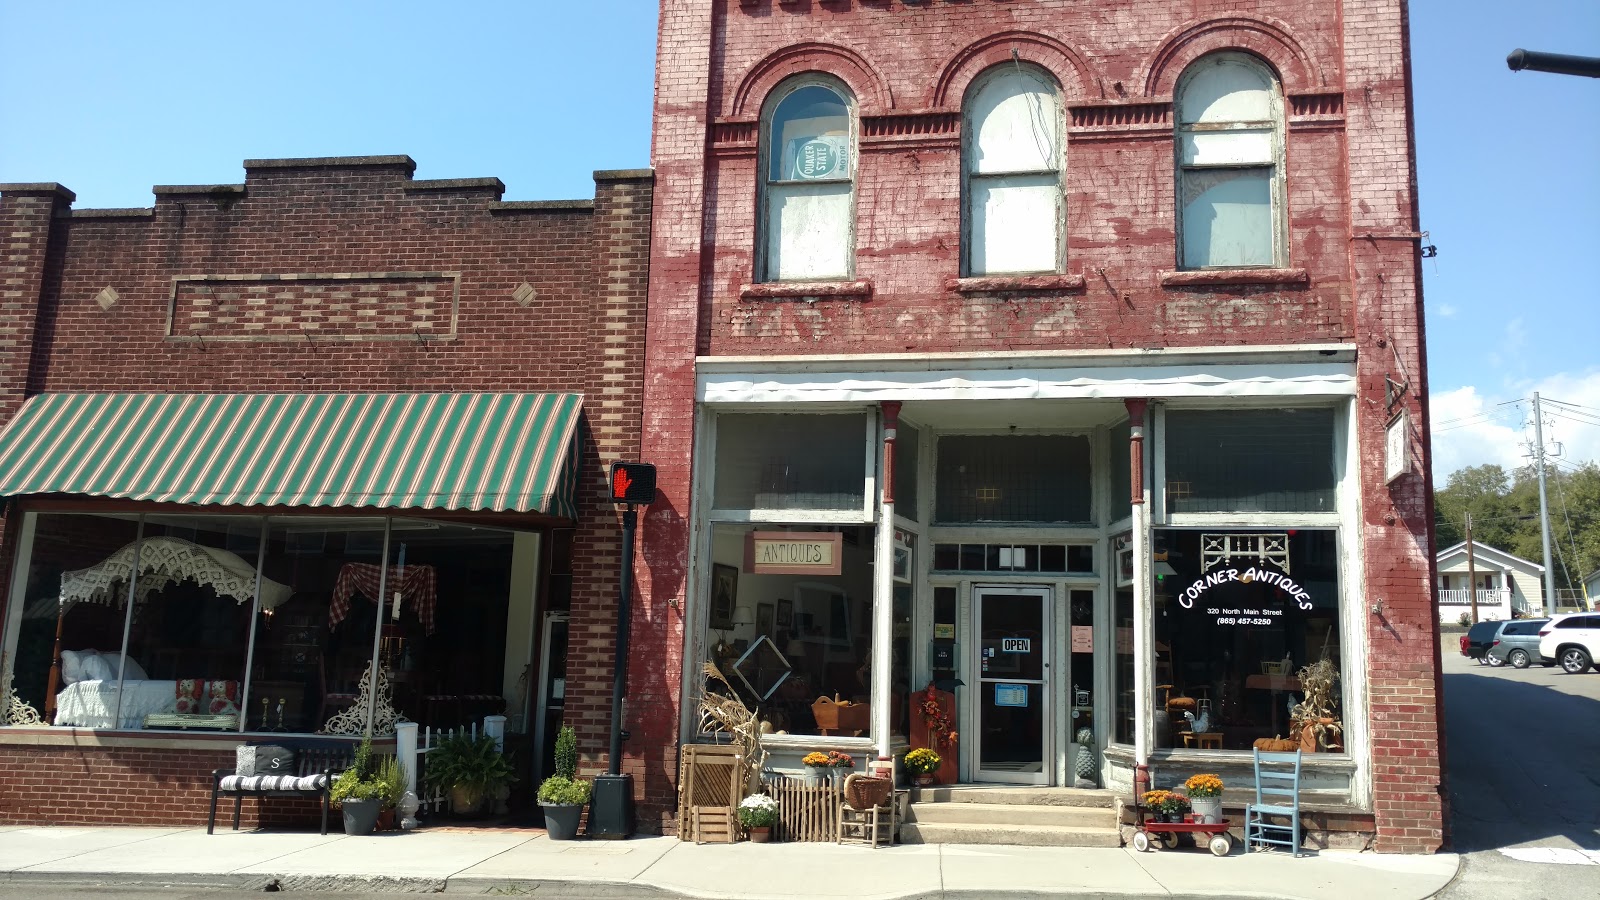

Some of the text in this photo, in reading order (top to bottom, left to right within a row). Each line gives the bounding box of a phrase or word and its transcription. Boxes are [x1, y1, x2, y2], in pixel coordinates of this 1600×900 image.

[804, 145, 815, 175] QUAKER
[816, 147, 827, 171] STATE
[839, 145, 847, 171] MOTOR
[763, 543, 822, 563] ANTIQUES
[1178, 566, 1313, 611] CORNER ANTIQUES
[1216, 617, 1272, 626] (865) 457-5250
[1243, 608, 1260, 616] Main
[1262, 608, 1283, 616] Street
[1004, 639, 1029, 651] OPEN
[270, 757, 280, 769] S
